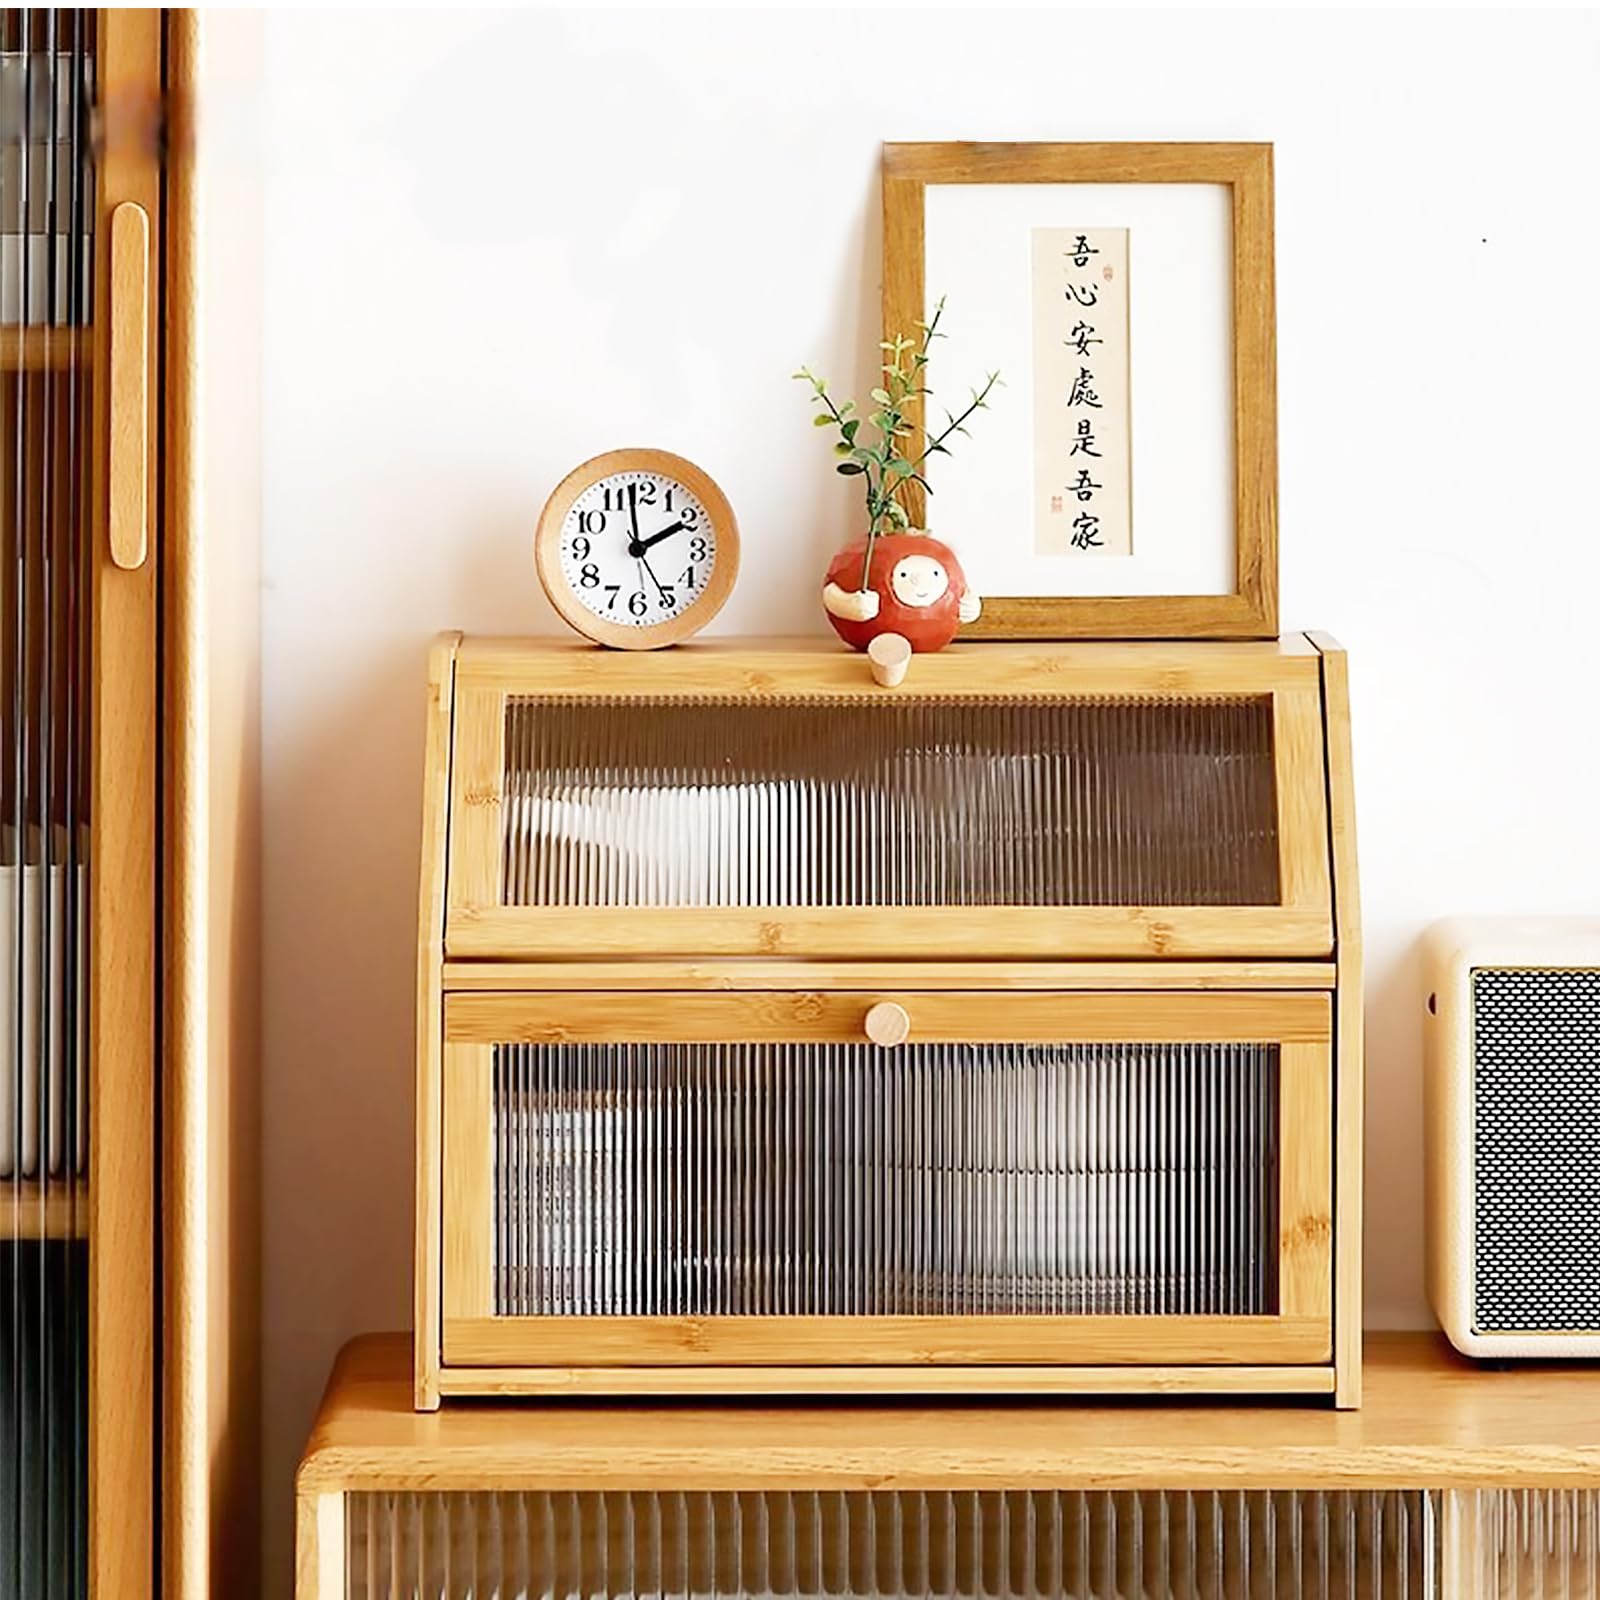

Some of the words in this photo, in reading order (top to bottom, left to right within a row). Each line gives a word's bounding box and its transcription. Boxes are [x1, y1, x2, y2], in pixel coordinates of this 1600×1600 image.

[603, 488, 624, 511] 11
[664, 489, 673, 512] 1
[578, 510, 606, 535] 10
[681, 507, 698, 532] 2
[572, 537, 590, 561] 9
[690, 537, 706, 562] 3
[580, 563, 600, 588] 8
[678, 566, 696, 589] 4
[604, 585, 621, 610] 7
[628, 591, 647, 617] 6
[659, 585, 676, 609] 5
